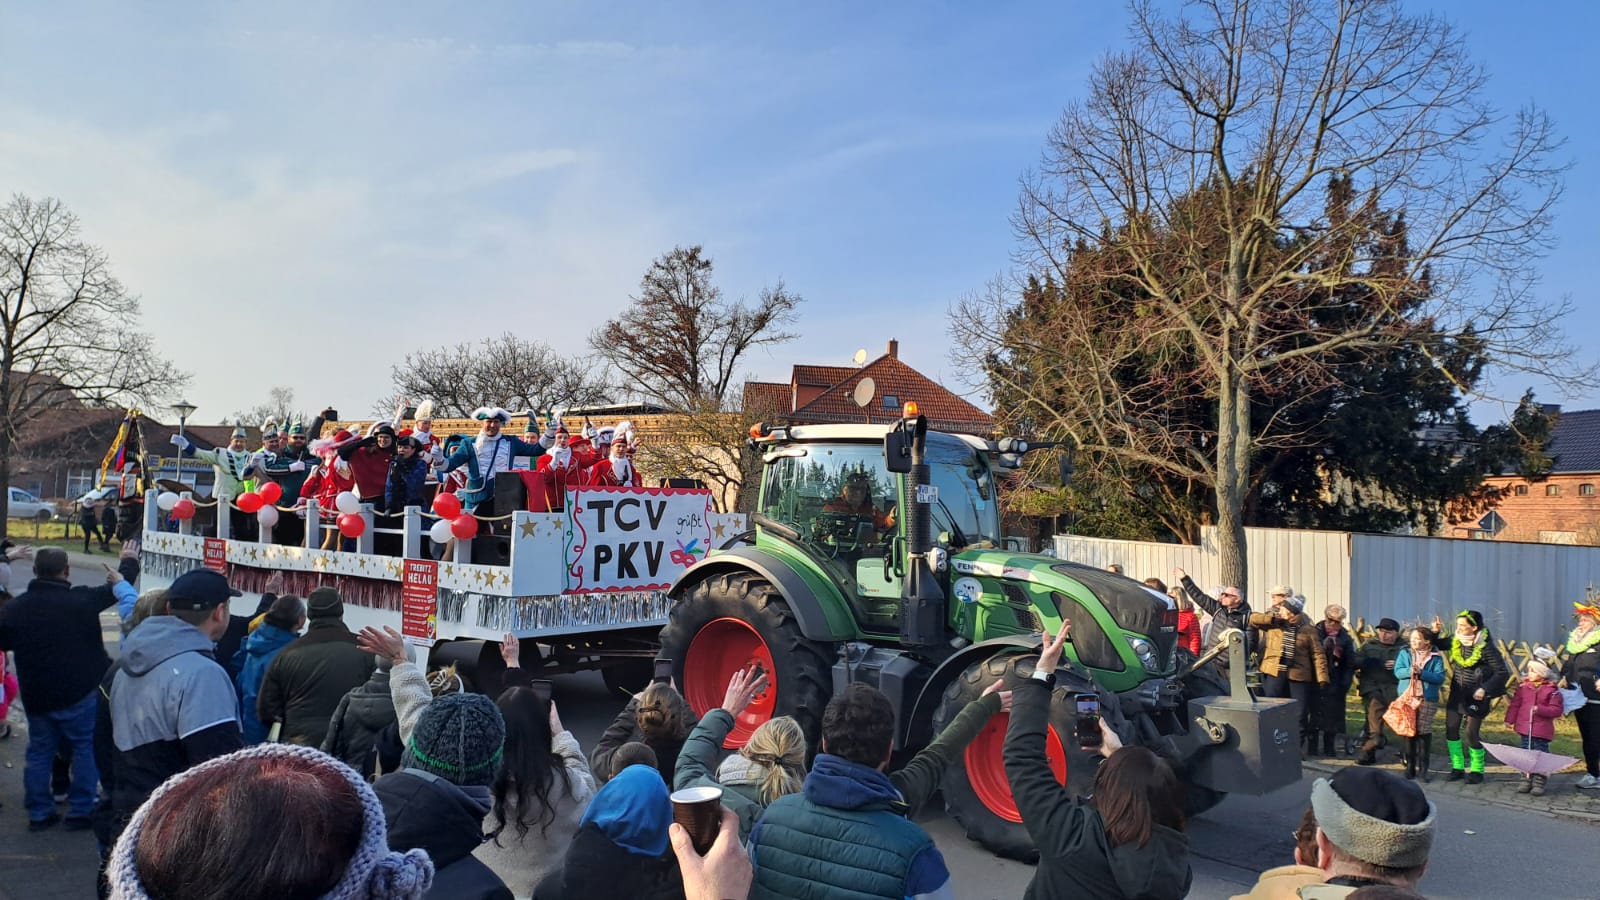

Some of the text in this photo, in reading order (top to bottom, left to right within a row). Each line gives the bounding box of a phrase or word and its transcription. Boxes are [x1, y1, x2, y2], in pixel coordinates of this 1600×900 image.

[587, 498, 667, 532] TCV
[675, 513, 703, 536] grüßt
[593, 541, 664, 582] PKV
[407, 573, 433, 585] HELAU
